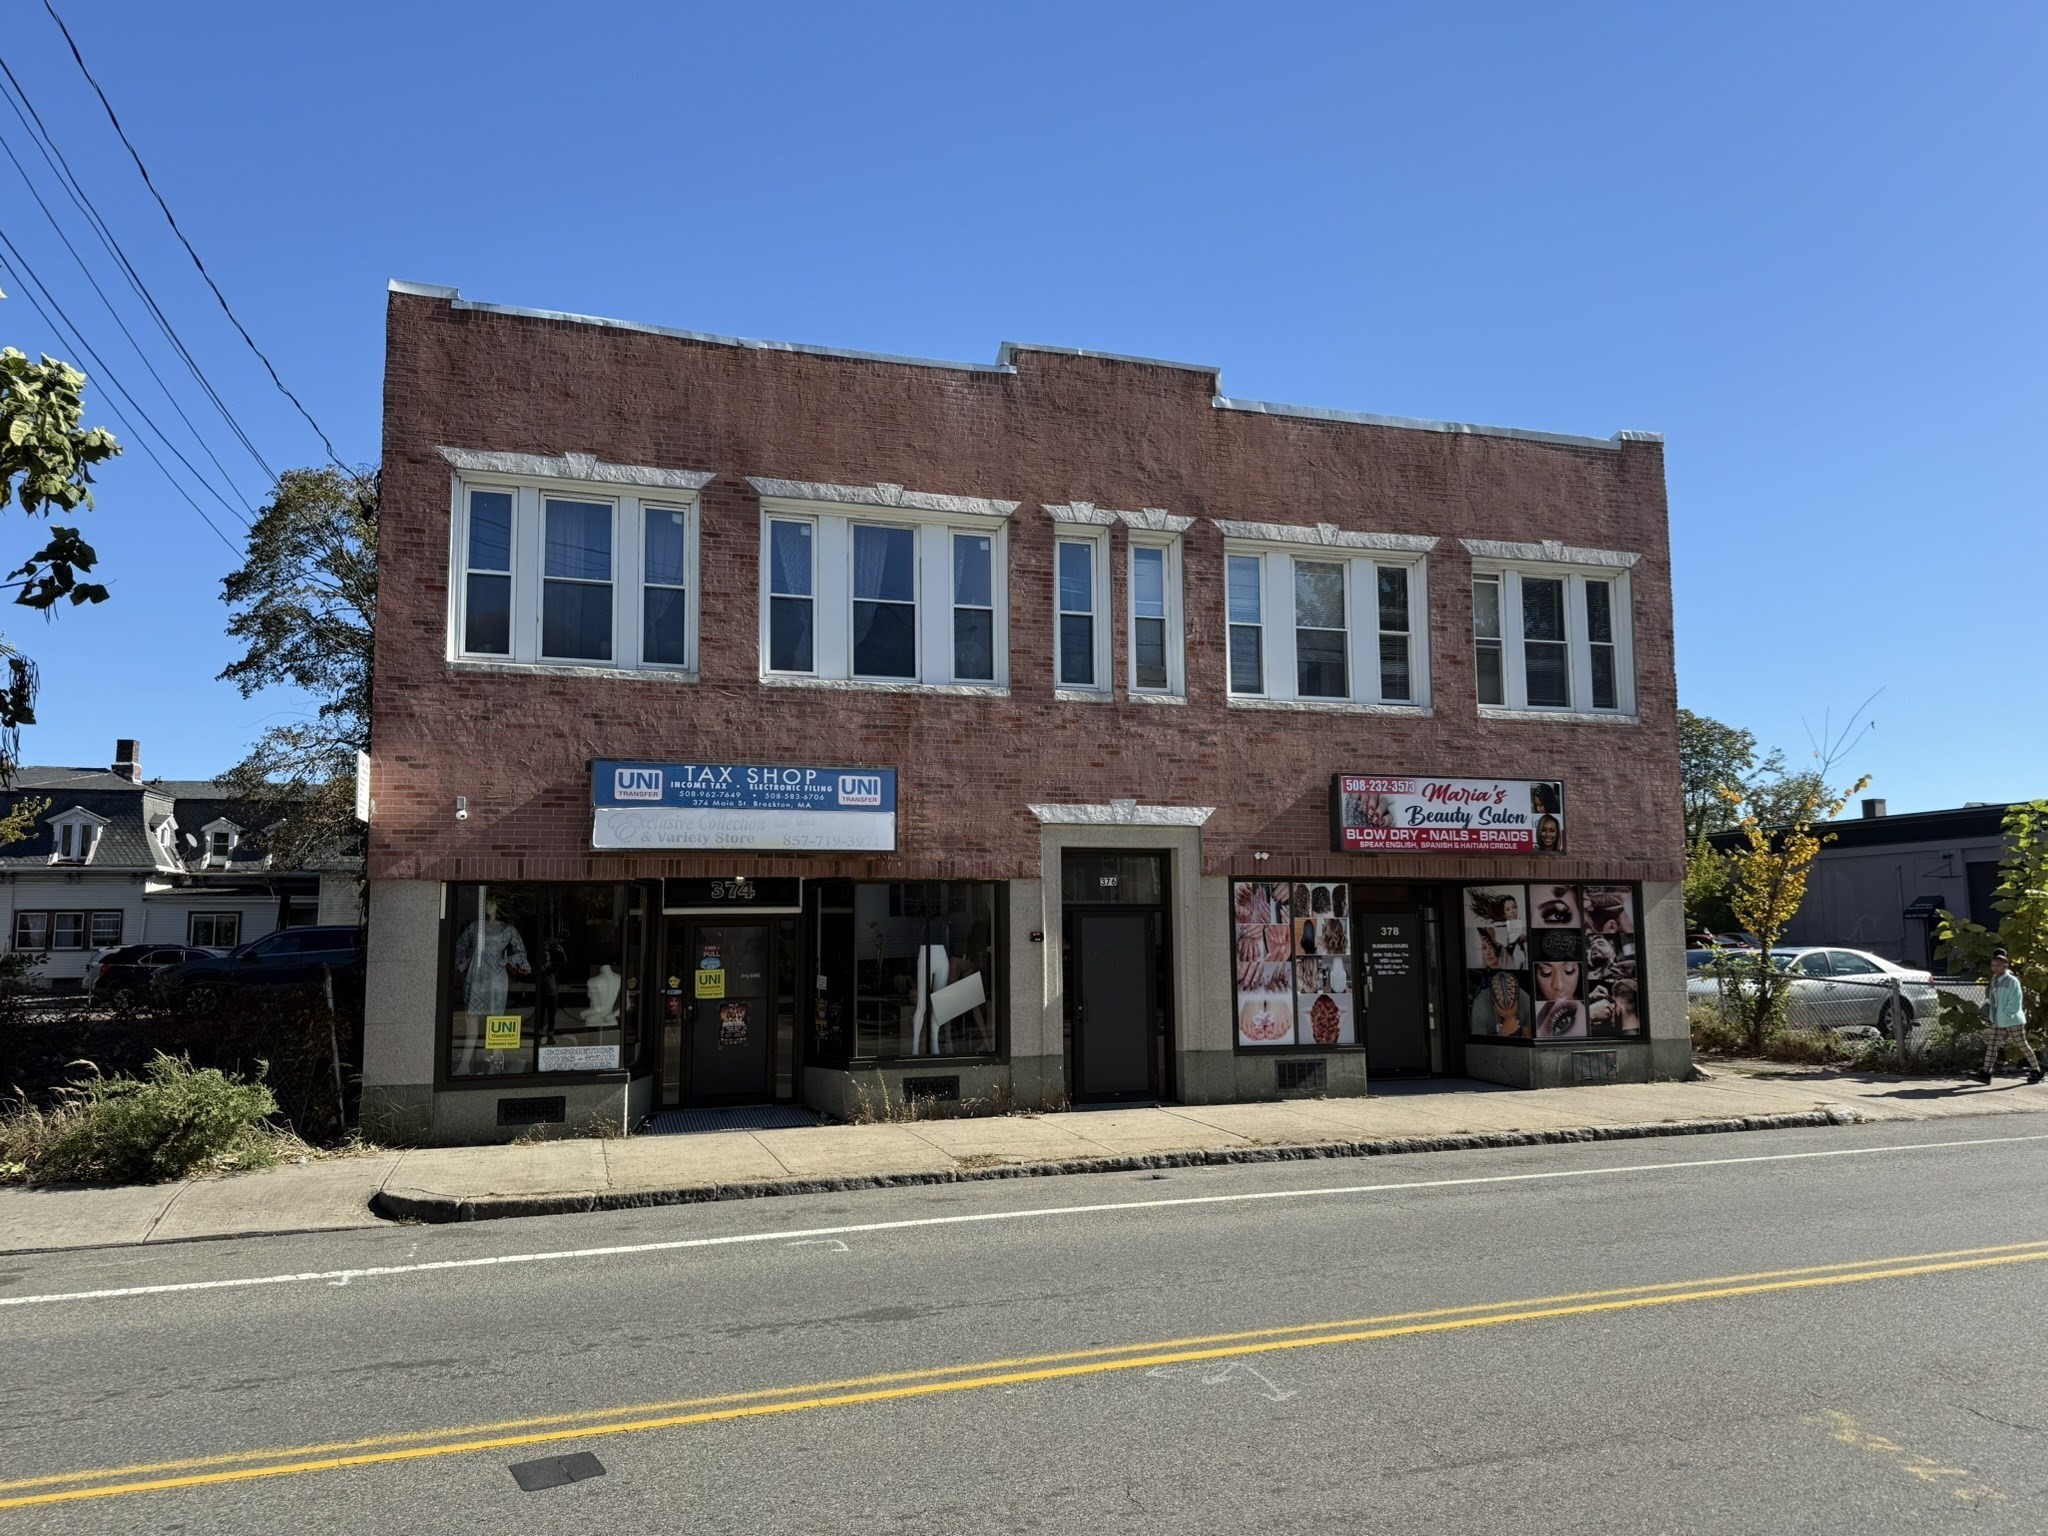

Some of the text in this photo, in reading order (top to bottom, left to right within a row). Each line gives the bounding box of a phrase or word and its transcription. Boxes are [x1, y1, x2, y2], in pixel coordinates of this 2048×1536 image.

[618, 771, 660, 790] UNI
[684, 765, 817, 785] TAX SHOP
[670, 781, 727, 790] INCOME TAX
[749, 783, 833, 793] ELECTRONIC FILING
[841, 778, 879, 796] UNI
[1345, 779, 1416, 793] 508-232-3573
[618, 790, 659, 798] TRANSFER
[679, 790, 741, 798] 508-962-7649
[765, 792, 824, 801] 508-583-6706
[1421, 782, 1508, 805] Maria's
[1404, 805, 1473, 829] Beauty
[1478, 805, 1528, 826] Salon
[607, 812, 694, 843] Exclusive
[699, 811, 765, 831] Collection
[640, 831, 755, 845] & Variety Store
[1346, 829, 1387, 840] BLOW
[1389, 829, 1419, 840] DRY
[1429, 830, 1469, 841] NAILS
[1479, 831, 1529, 842] BRAIDS
[1385, 841, 1419, 849] ENGLISH,
[1101, 878, 1116, 886] 376
[710, 880, 756, 899] 374
[1380, 926, 1400, 936] 378
[699, 974, 721, 985] UNI
[491, 1021, 517, 1033] UNI
